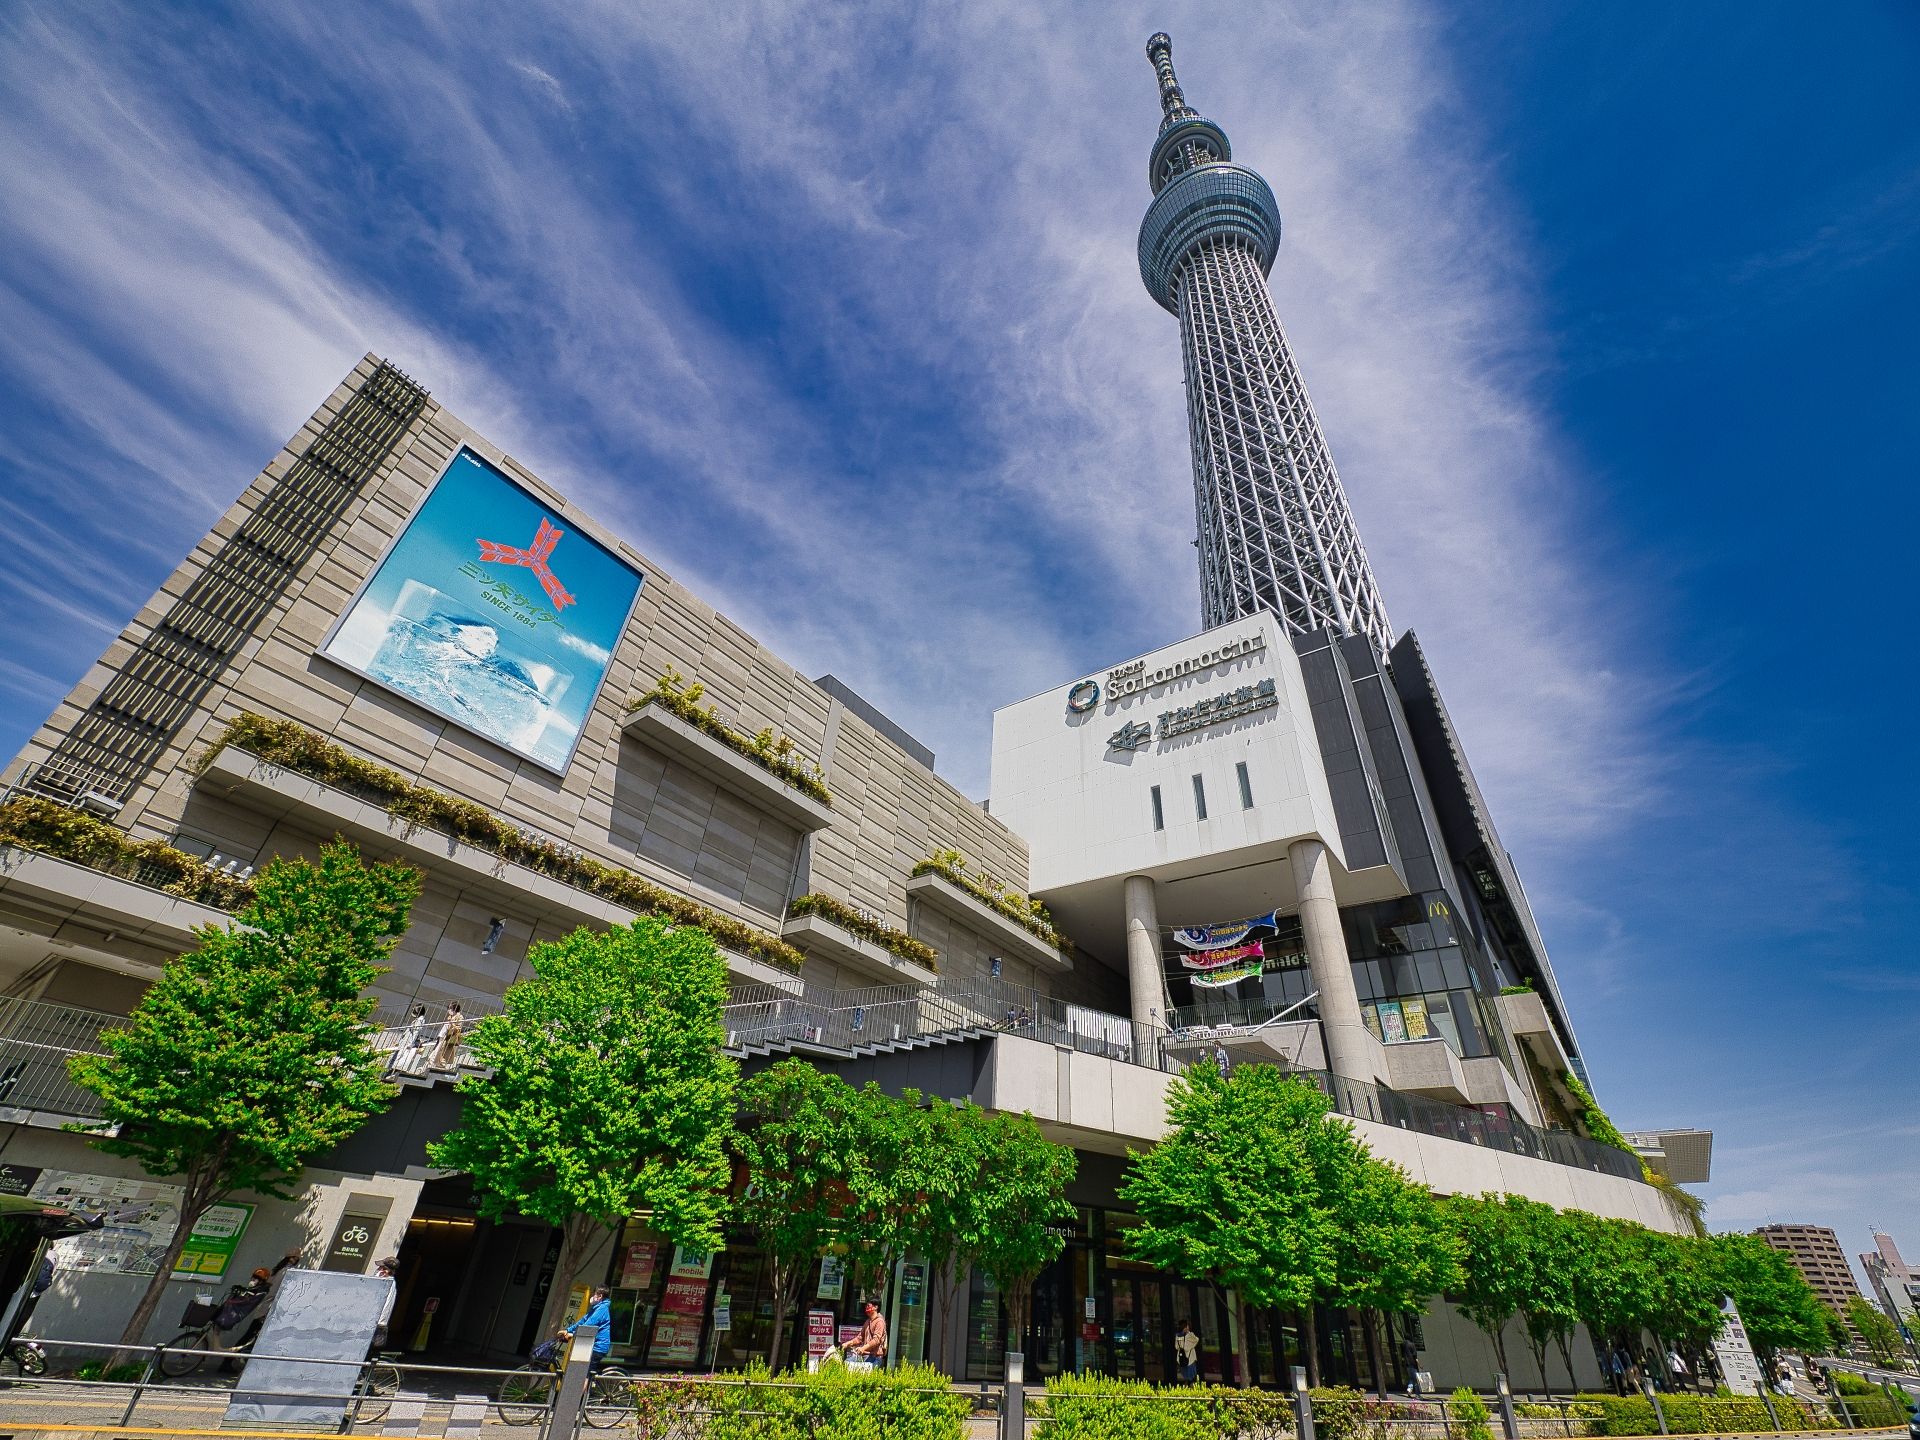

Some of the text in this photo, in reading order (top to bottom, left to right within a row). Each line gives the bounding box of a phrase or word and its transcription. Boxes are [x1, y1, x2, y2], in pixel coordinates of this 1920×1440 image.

[458, 561, 564, 629] 三ツ矢サイダー
[480, 590, 537, 629] SINCE 1884
[1106, 659, 1146, 681] TOKYO
[1107, 626, 1267, 700] Solamachi
[1157, 677, 1276, 728] すみだ水族館
[667, 1283, 706, 1297] 好評受付中
[678, 1267, 704, 1275] mobile
